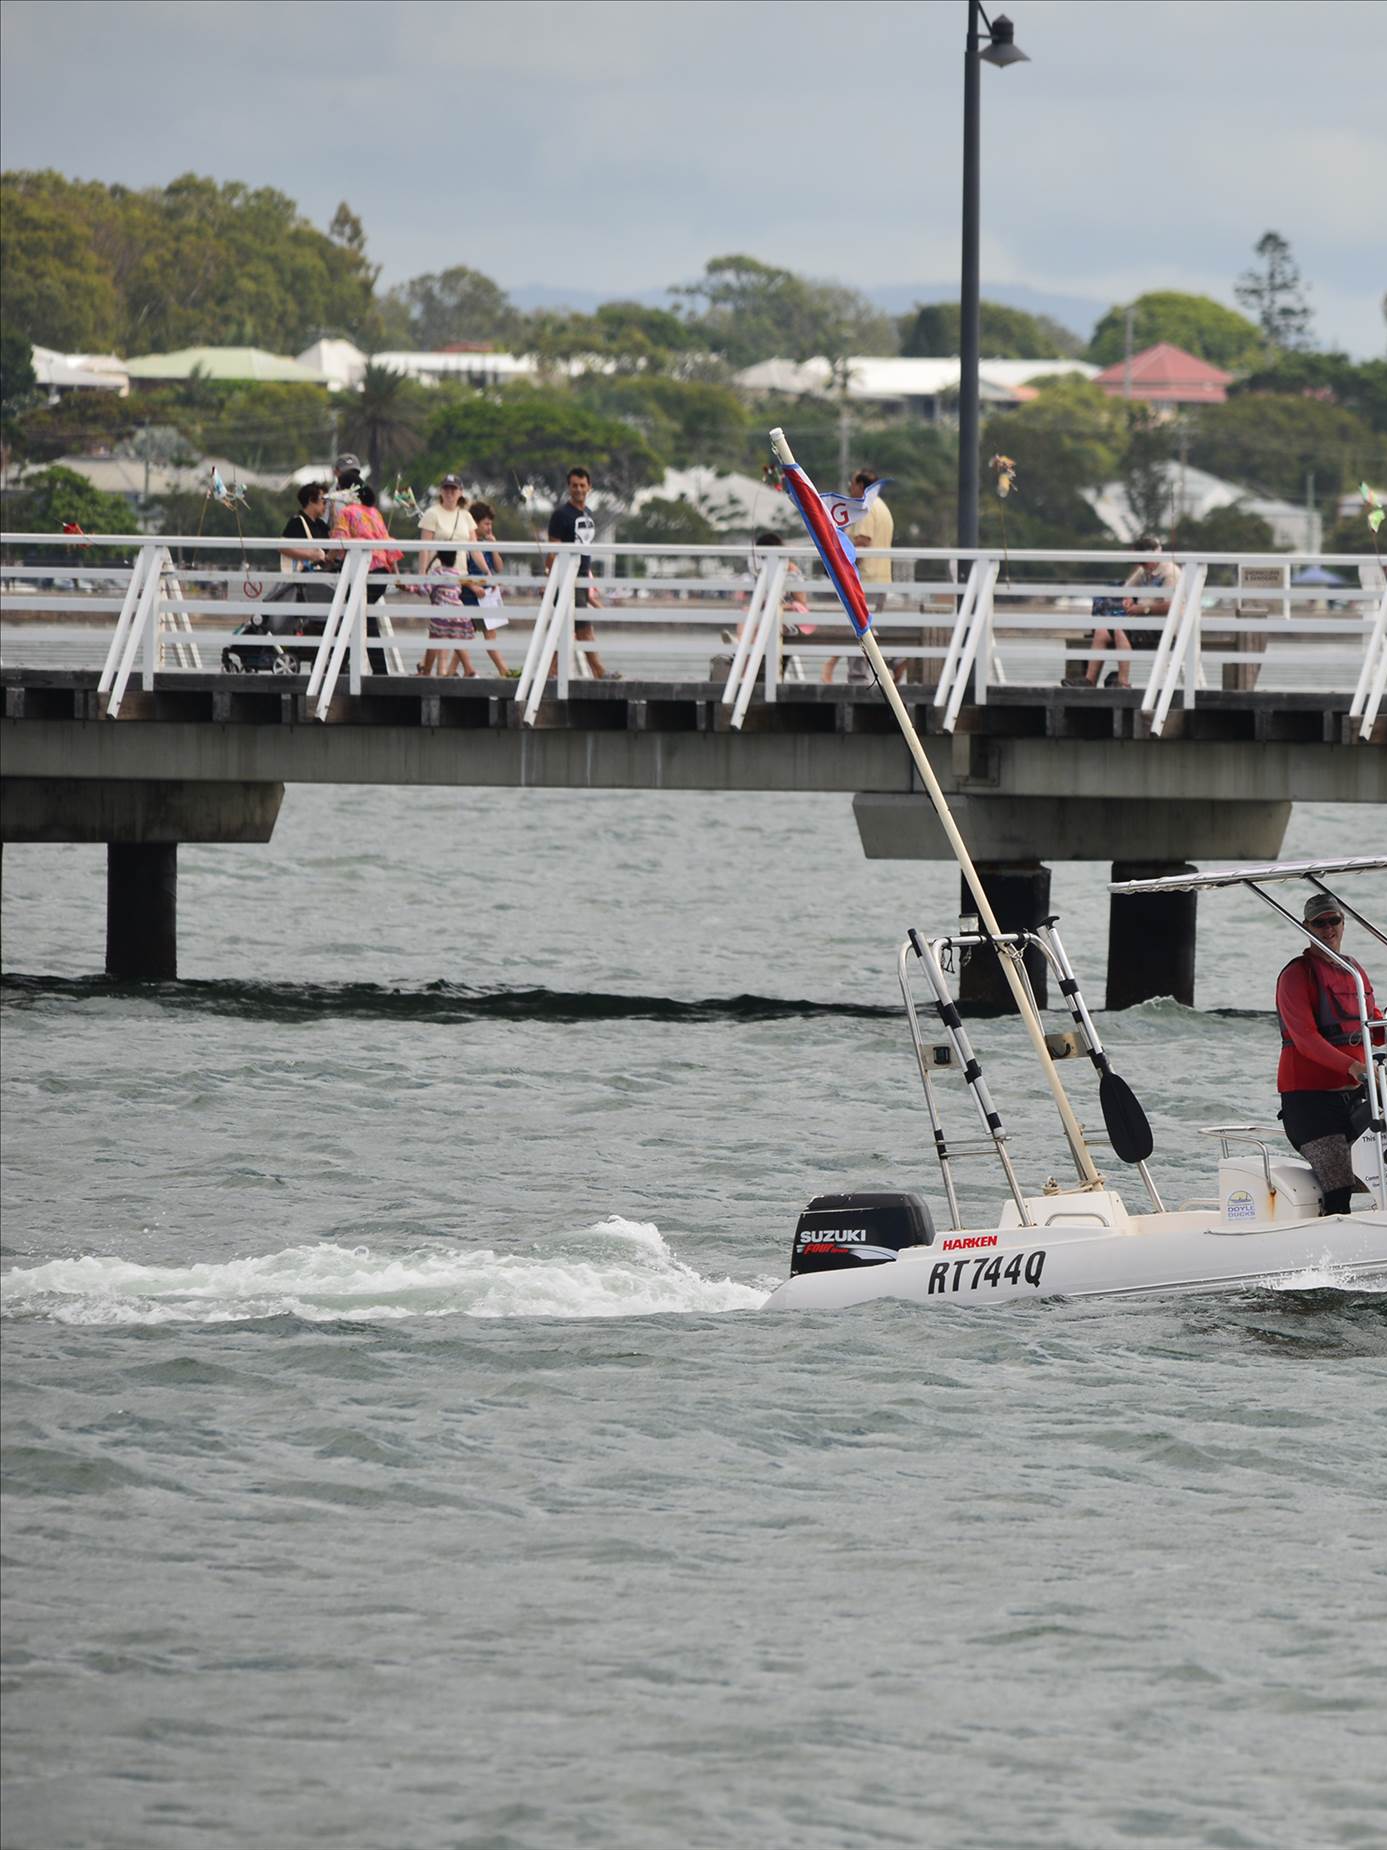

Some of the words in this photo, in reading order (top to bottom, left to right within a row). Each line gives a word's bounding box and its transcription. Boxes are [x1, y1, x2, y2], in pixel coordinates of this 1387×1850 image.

[831, 502, 849, 526] G
[800, 1229, 867, 1244] SUZUKI
[943, 1235, 998, 1251] HARKEN
[928, 1251, 1046, 1294] RT744Q
